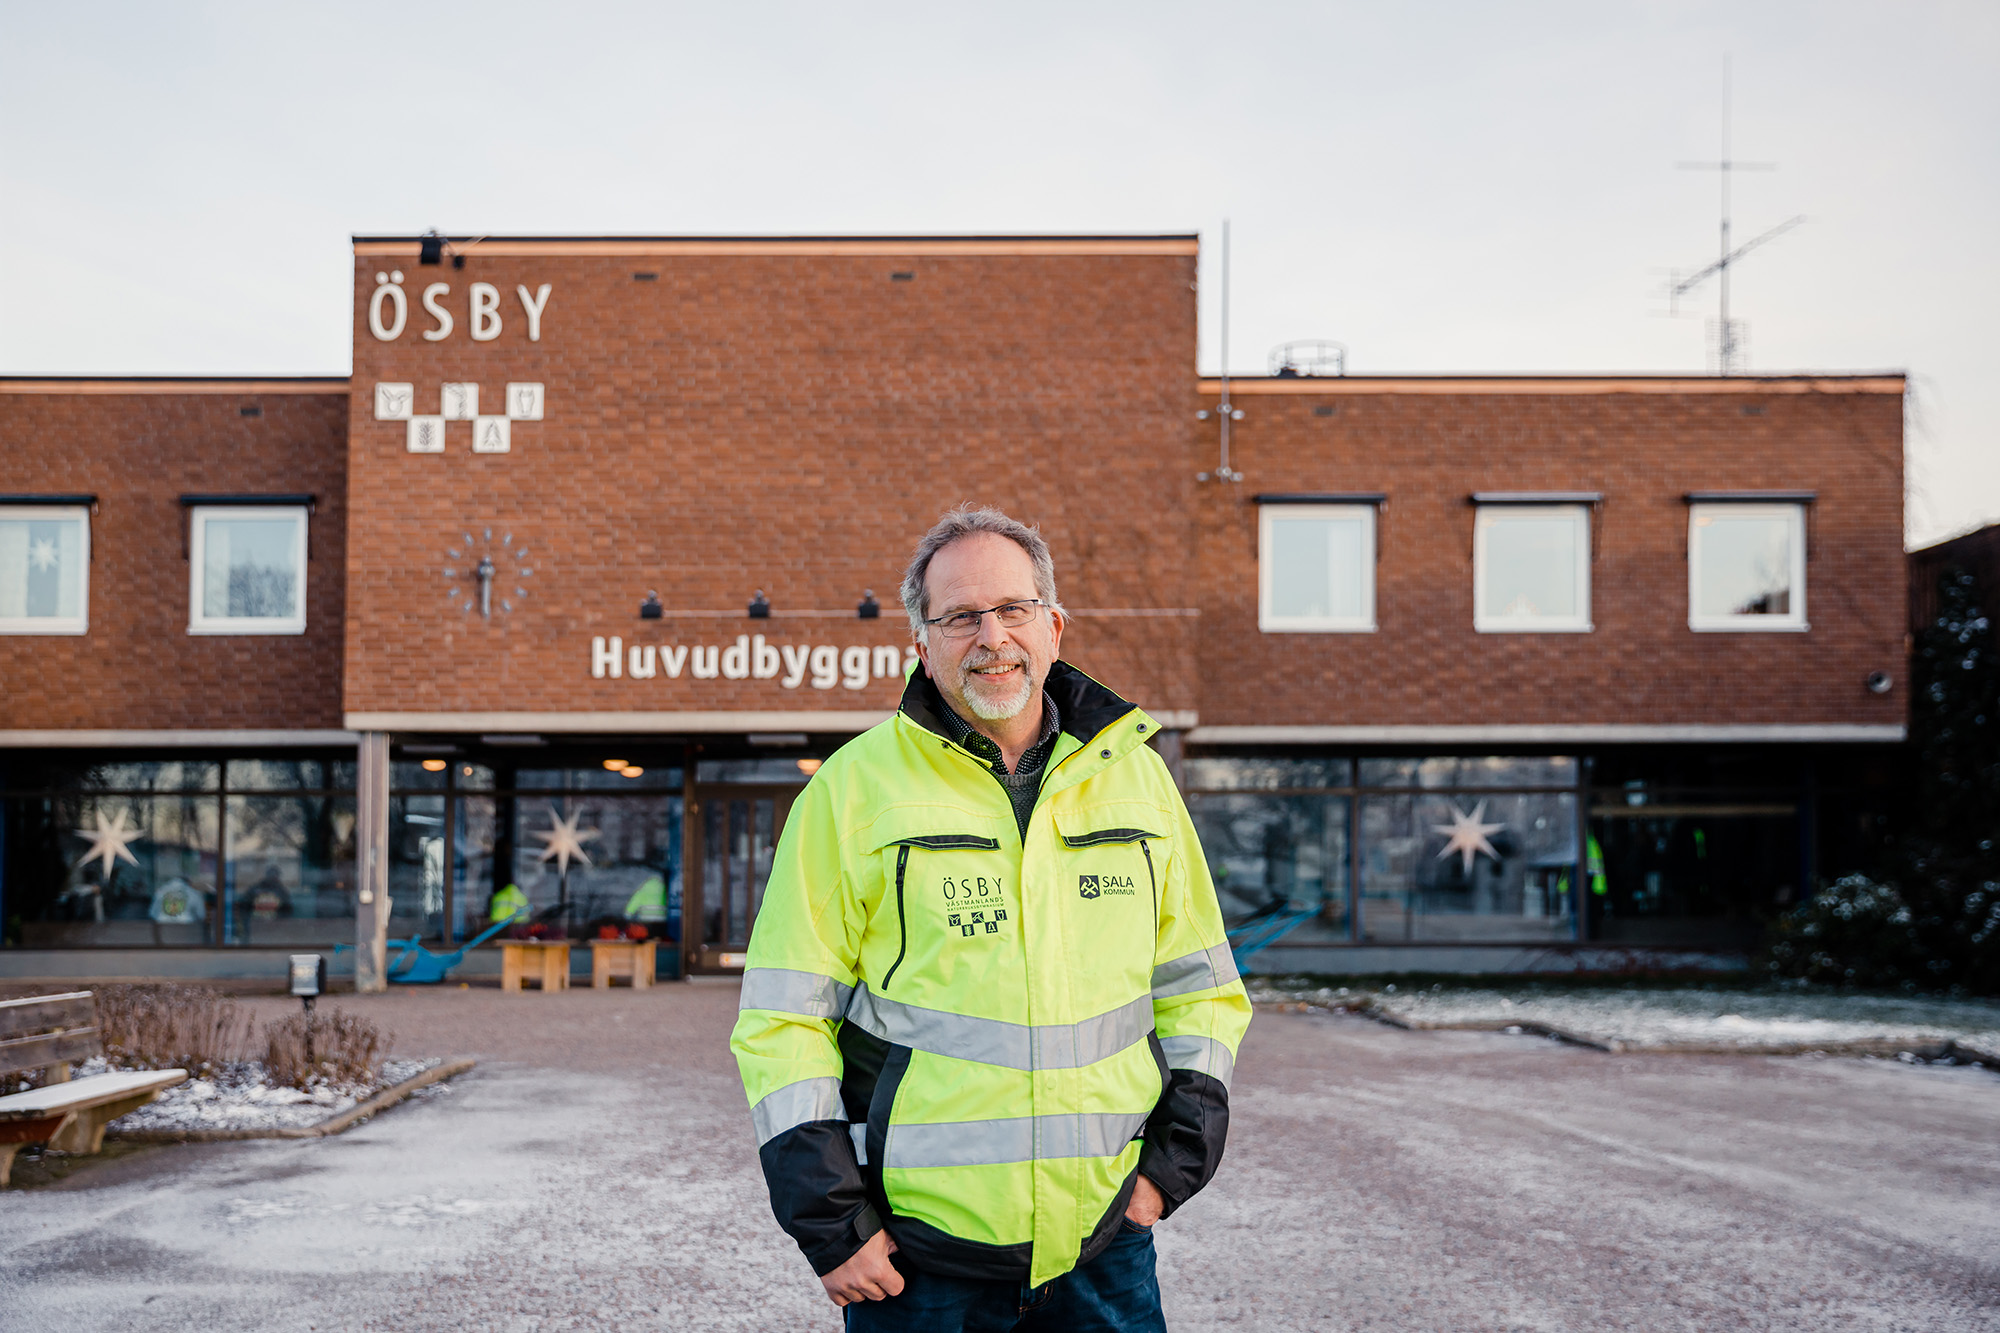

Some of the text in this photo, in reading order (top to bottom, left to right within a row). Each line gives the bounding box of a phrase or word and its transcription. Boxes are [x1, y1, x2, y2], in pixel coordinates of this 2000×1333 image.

[368, 269, 553, 342] ÖSBY
[942, 876, 1002, 900] ÖSBY
[1102, 876, 1134, 888] SALA
[1103, 888, 1136, 896] KOMMUN
[945, 896, 1004, 908] VÄSTMANLANDS
